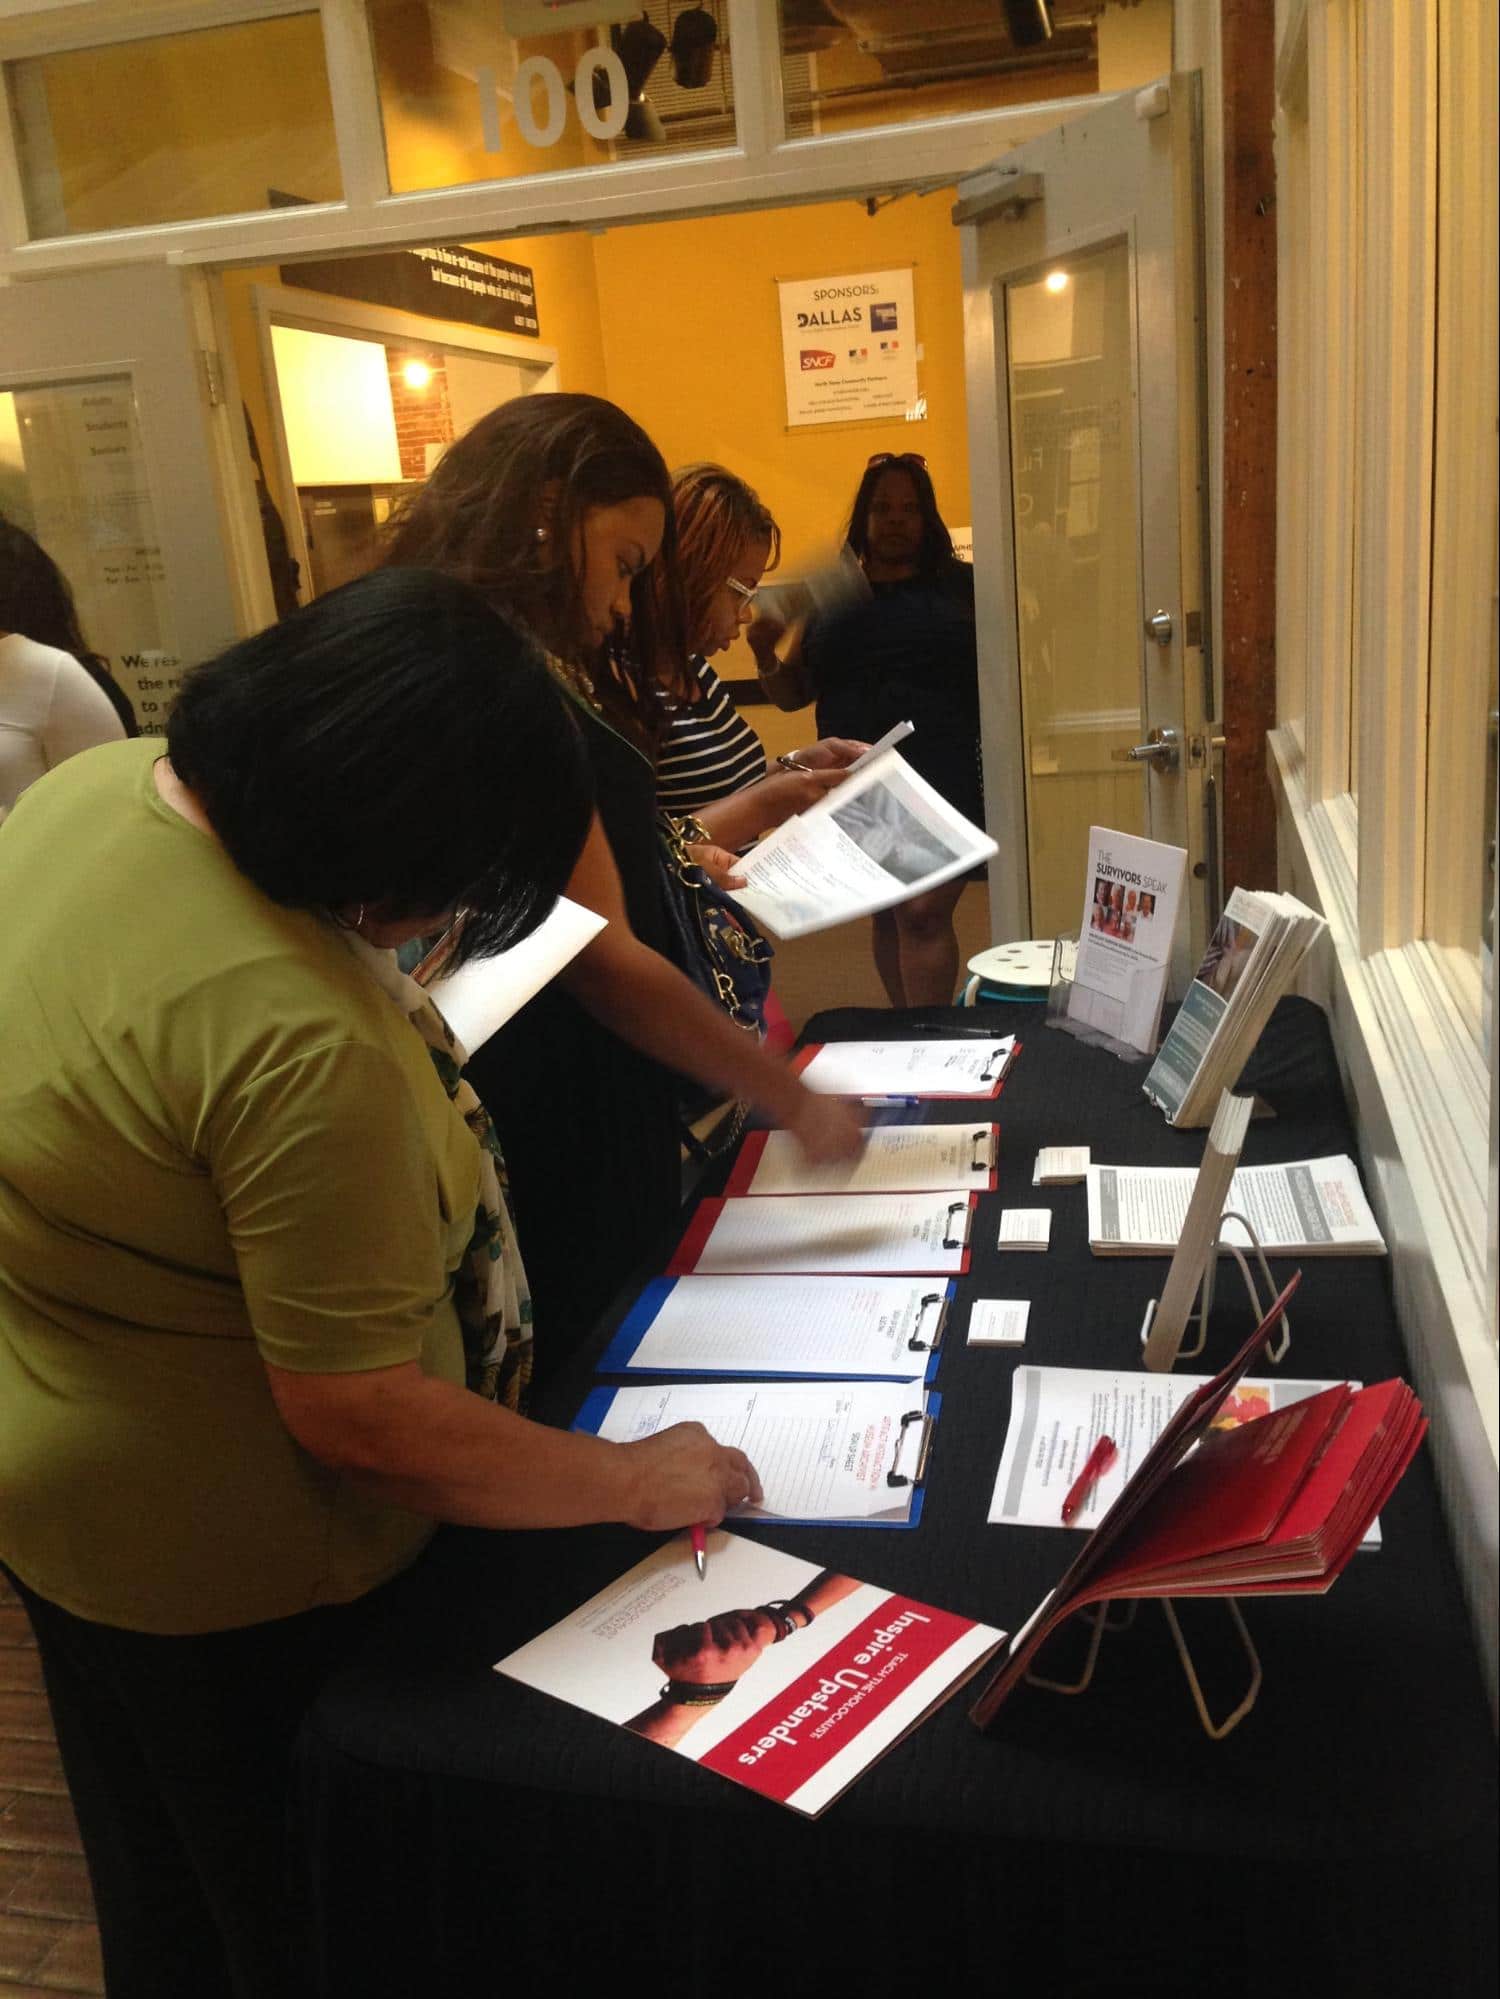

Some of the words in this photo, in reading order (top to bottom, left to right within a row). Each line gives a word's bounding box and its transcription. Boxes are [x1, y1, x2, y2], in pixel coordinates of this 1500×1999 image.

[478, 47, 630, 154] 100
[813, 283, 880, 301] SPONSORS:
[797, 306, 863, 328] DALLAS
[802, 354, 834, 369] SNCF
[121, 655, 150, 669] We
[155, 656, 182, 667] res
[137, 677, 163, 690] the
[142, 701, 158, 713] to
[1097, 850, 1112, 864] THE
[1096, 863, 1142, 886] SURVIVORS
[1142, 875, 1168, 895] SPEAK
[853, 1610, 931, 1665] Inspire
[878, 1651, 909, 1680] TEACH
[861, 1674, 883, 1694] THE
[738, 1668, 870, 1765] Upstanders
[809, 1688, 867, 1740] HOLOCAUST:
